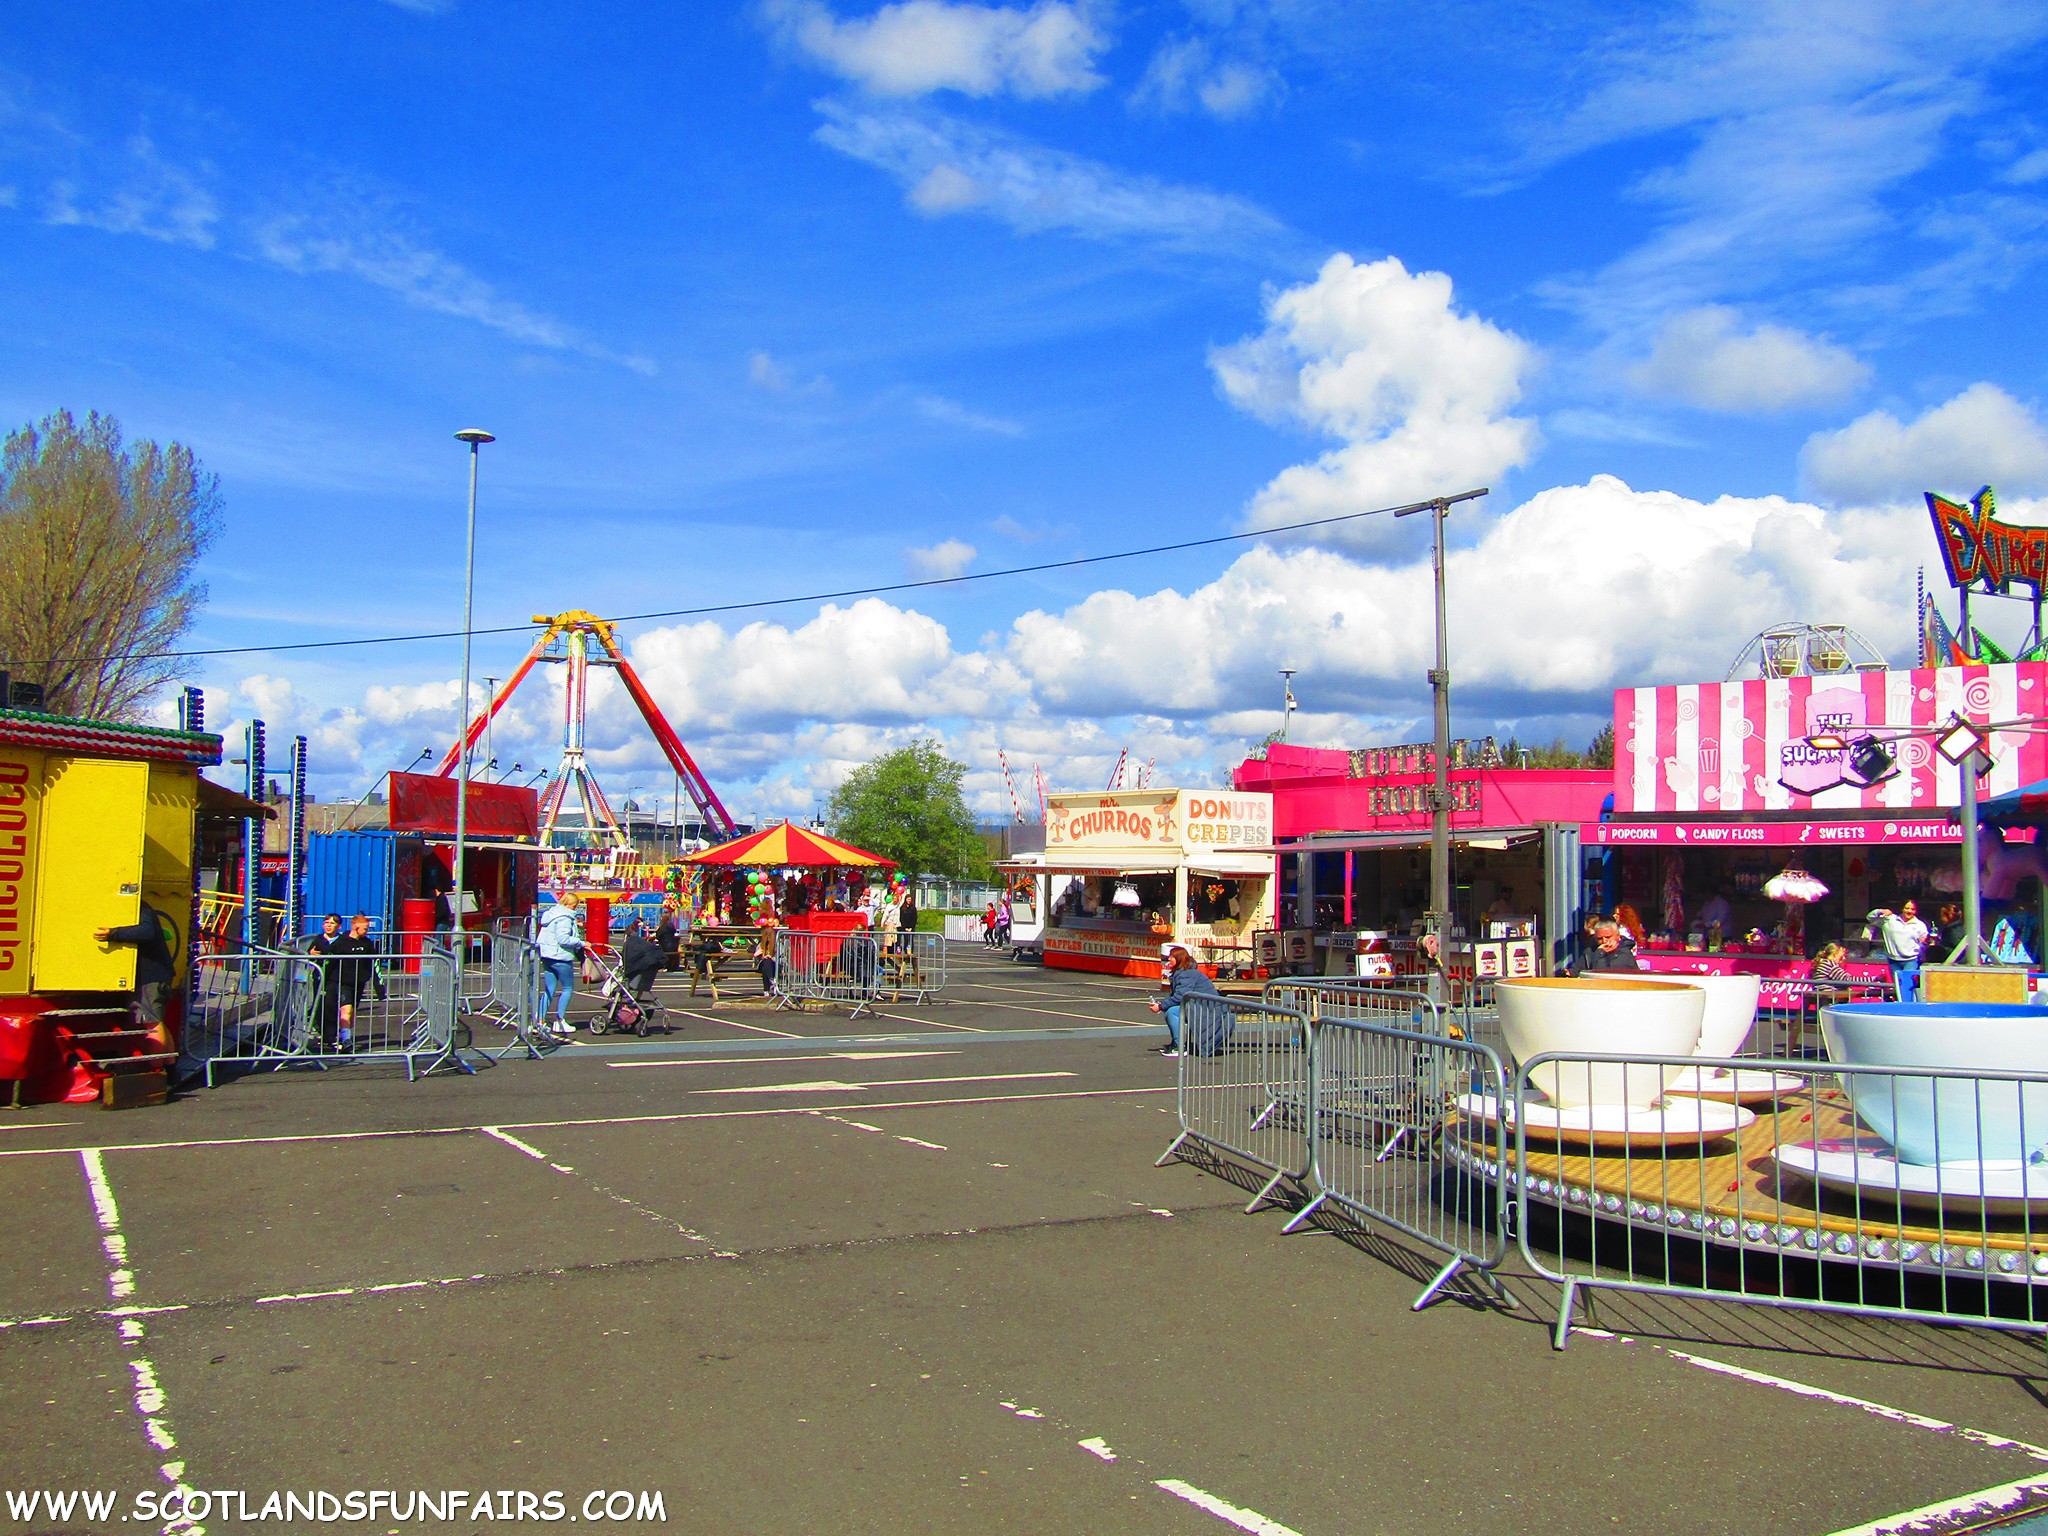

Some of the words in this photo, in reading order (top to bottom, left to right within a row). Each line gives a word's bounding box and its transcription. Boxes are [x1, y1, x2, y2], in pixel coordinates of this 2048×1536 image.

[1933, 490, 2048, 593] EXTRE
[1816, 713, 1852, 730] THE
[1347, 736, 1504, 779] NUTELA
[1849, 741, 1898, 760] CE
[1100, 797, 1120, 808] mr.
[1189, 799, 1267, 820] DONUTS
[1069, 810, 1153, 841] CHURROS
[1187, 823, 1267, 845] CREPES
[1611, 828, 1658, 840] POPCORN
[1692, 828, 1729, 840] CANDY
[1731, 828, 1765, 840] FLOSS
[1818, 827, 1866, 840] SWEETS
[1899, 825, 1939, 838] GIANT
[1941, 824, 1963, 837] LOL
[1045, 938, 1082, 951] WAFFLES
[1083, 941, 1114, 955] CREPES
[1115, 945, 1131, 956] HOT
[1131, 947, 1159, 959] CHOCOL
[1394, 955, 1426, 976] ella
